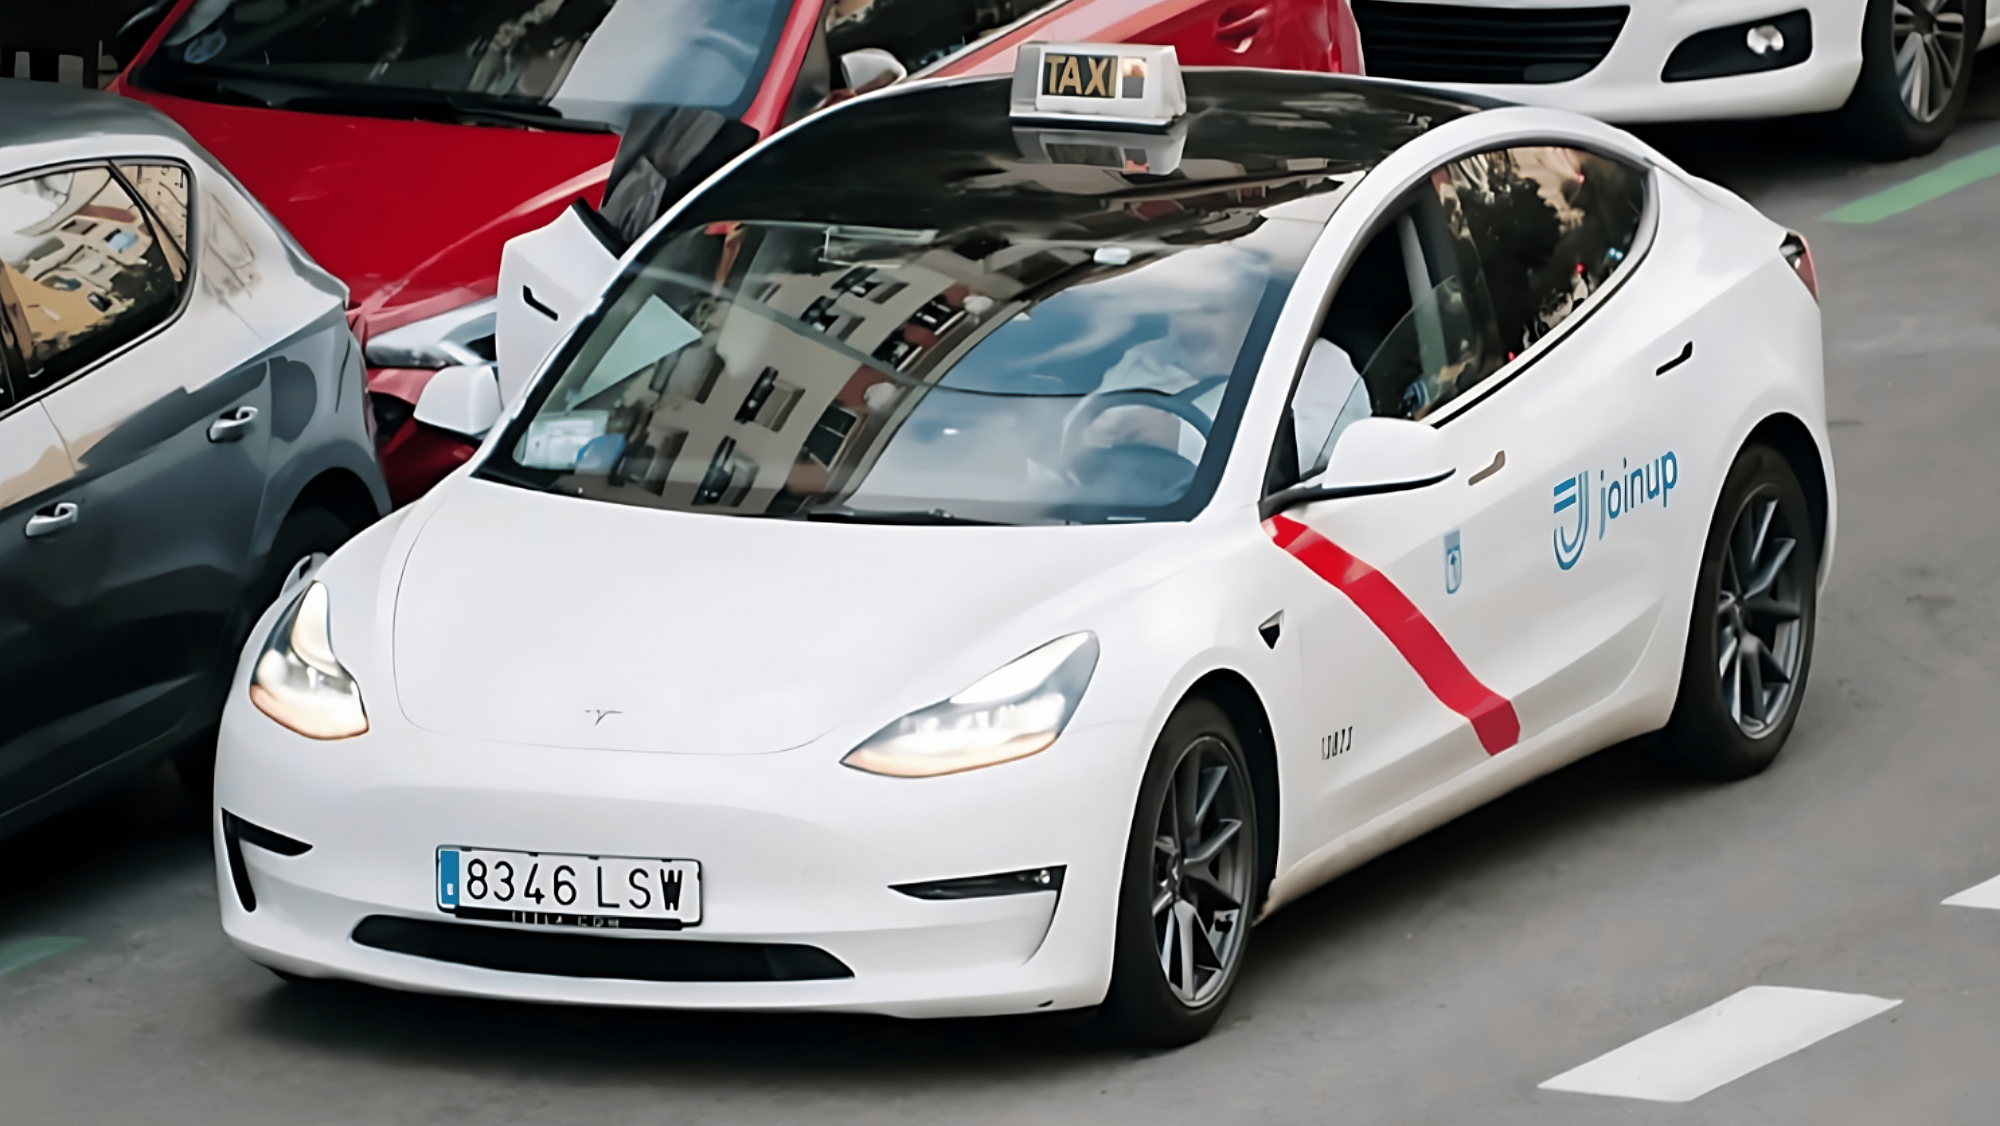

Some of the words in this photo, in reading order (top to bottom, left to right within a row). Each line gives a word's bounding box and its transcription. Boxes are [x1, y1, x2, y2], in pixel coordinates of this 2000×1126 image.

[1044, 55, 1118, 97] TAXI
[1599, 450, 1678, 541] joinup
[466, 858, 577, 906] 8346
[597, 865, 683, 911] LSW
